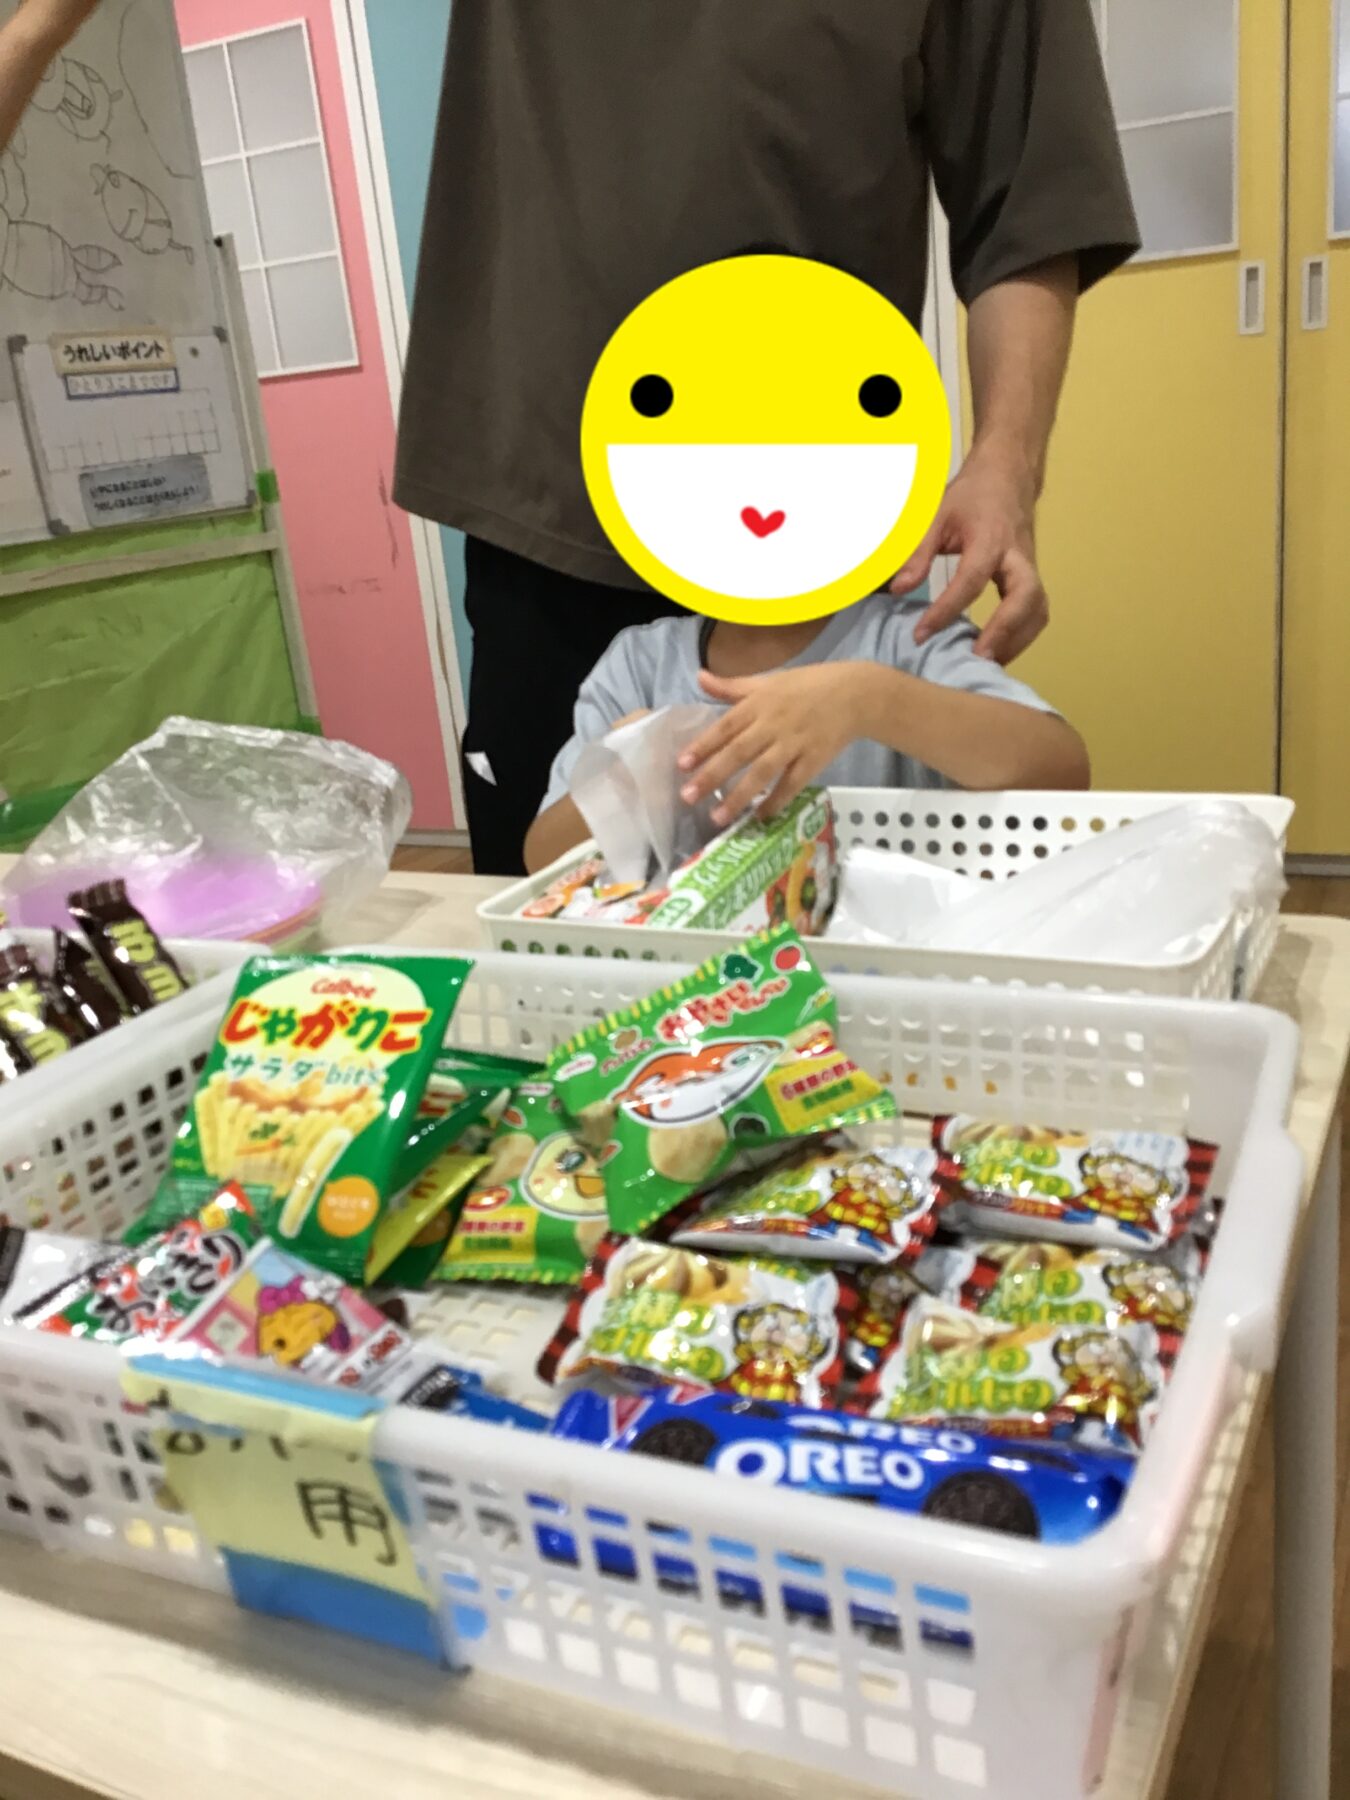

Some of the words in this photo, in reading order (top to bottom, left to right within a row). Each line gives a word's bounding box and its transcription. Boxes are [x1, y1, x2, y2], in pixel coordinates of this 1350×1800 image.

[63, 340, 165, 364] うれしいポイント
[311, 977, 376, 999] Calbee
[221, 998, 432, 1053] じゃがりこ
[713, 1437, 924, 1490] OREO
